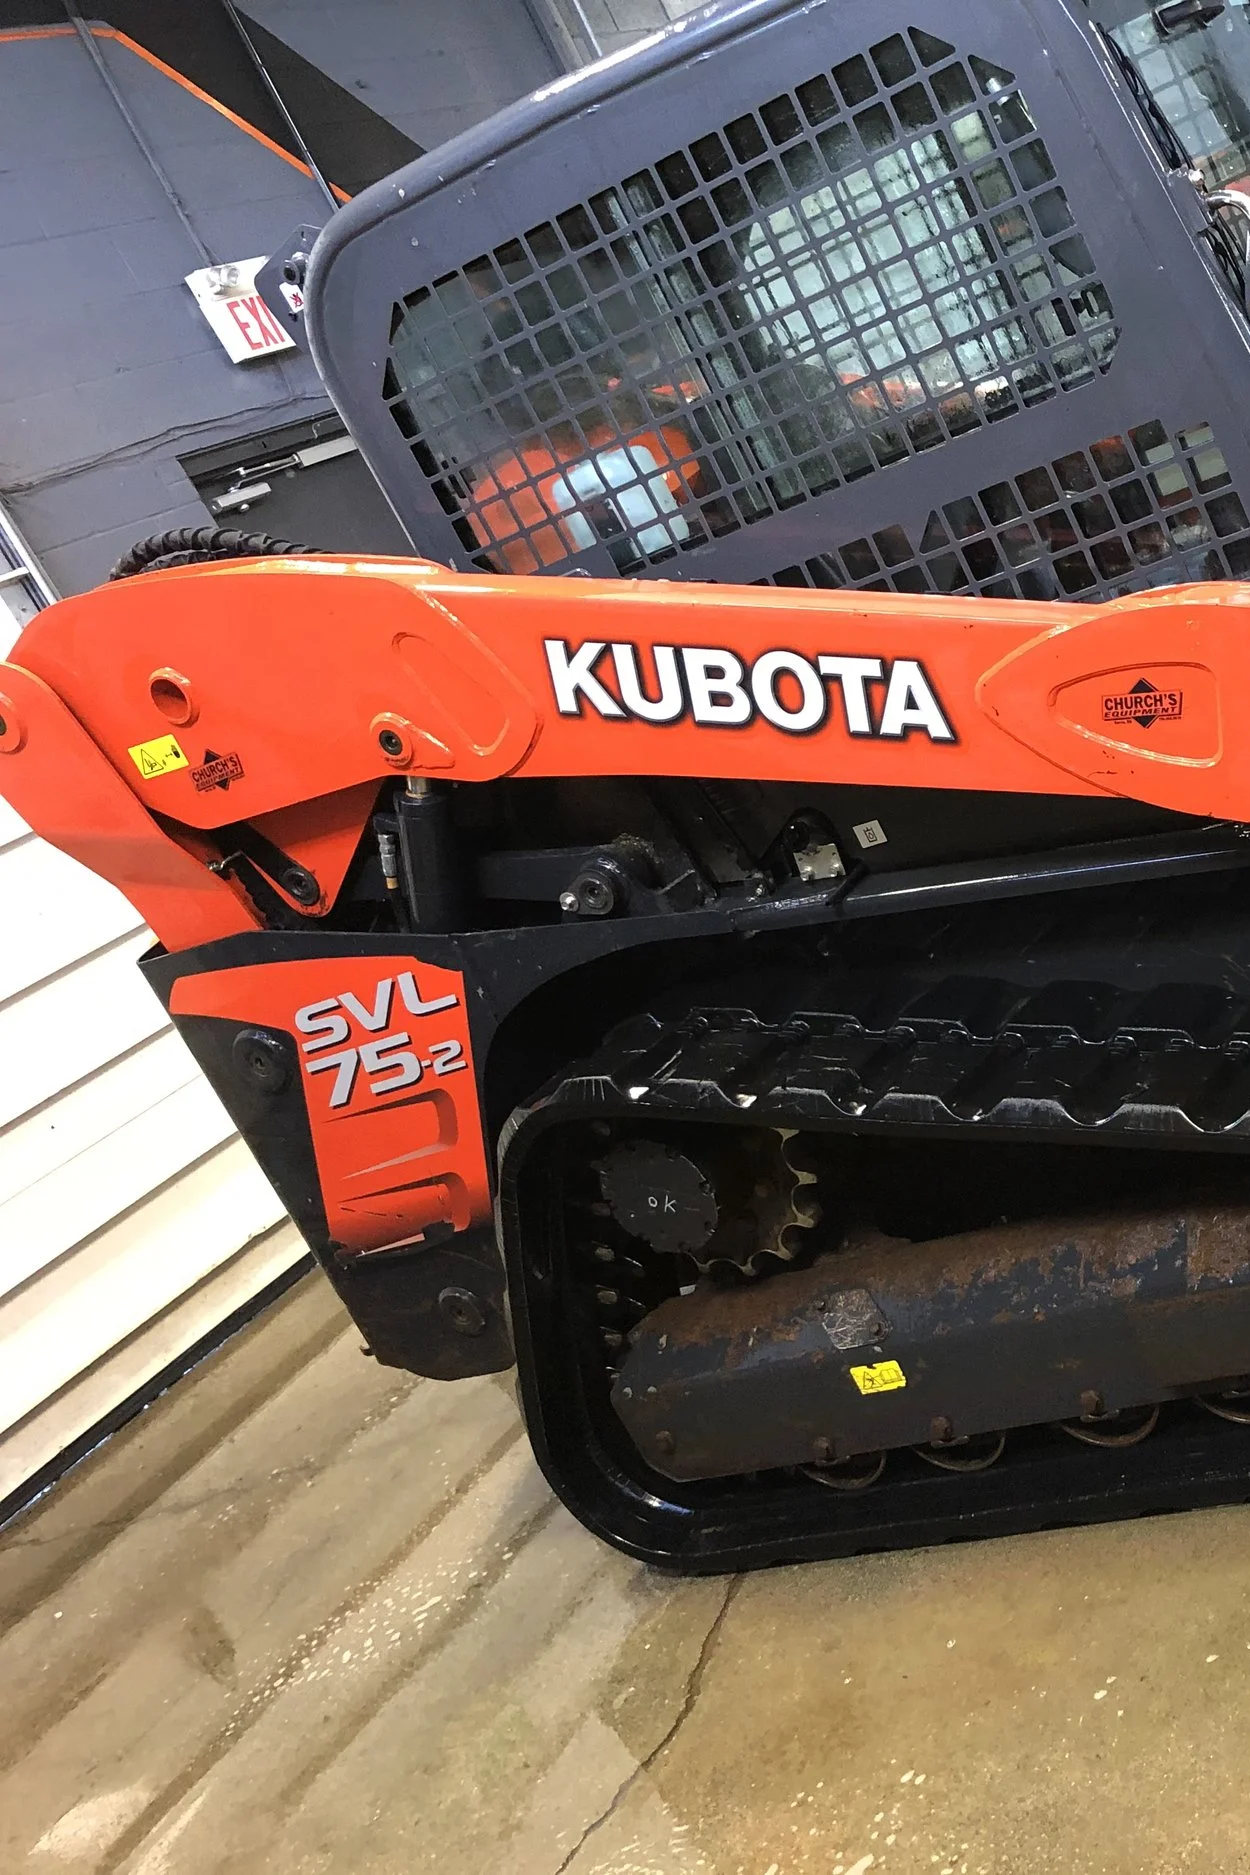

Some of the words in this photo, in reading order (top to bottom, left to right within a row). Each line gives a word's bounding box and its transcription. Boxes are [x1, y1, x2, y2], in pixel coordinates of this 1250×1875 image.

[226, 295, 285, 350] EXI
[543, 638, 957, 743] KUBOTA
[1103, 706, 1178, 718] EQUIPMENT
[1104, 693, 1178, 711] CHURCH'S
[191, 756, 238, 783] CHURCH'S
[294, 971, 461, 1053] SVL
[305, 1031, 468, 1109] 75-2
